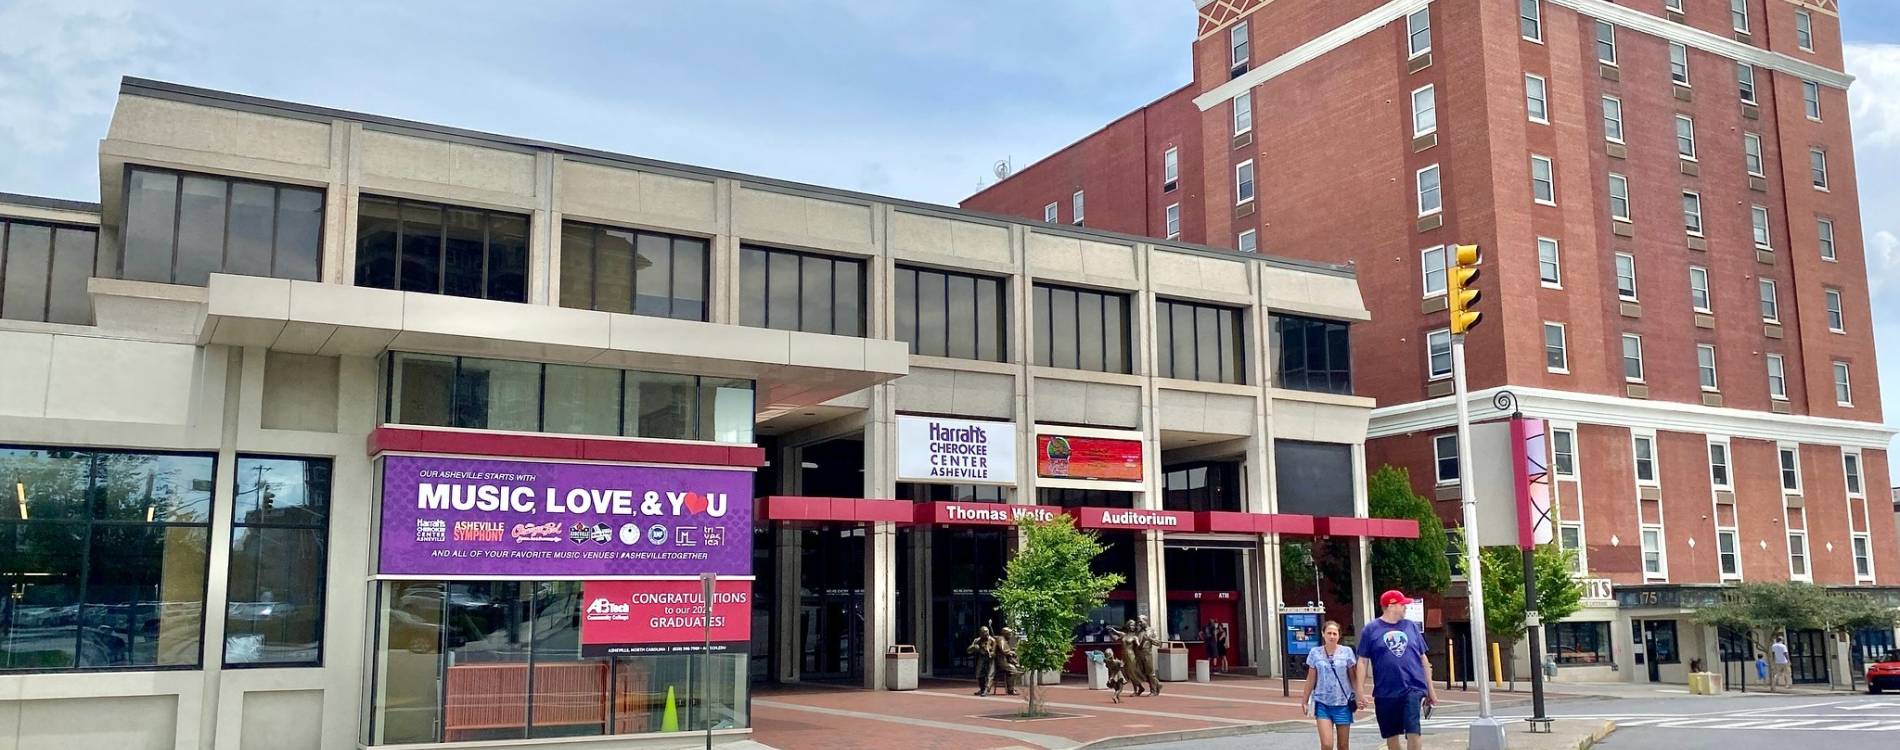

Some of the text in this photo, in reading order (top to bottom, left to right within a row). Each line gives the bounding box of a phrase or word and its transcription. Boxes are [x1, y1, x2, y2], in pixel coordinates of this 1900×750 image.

[929, 422, 987, 443] Harrah's
[929, 442, 987, 455] CHEROKEE
[930, 455, 987, 467] CENTER
[419, 470, 438, 478] OUR
[438, 471, 483, 479] ASHEVILLE
[484, 472, 514, 480] STARTS
[930, 467, 988, 478] ASHEVILLE
[417, 482, 536, 514] MUSIC,
[546, 487, 637, 517] LOVE,
[640, 490, 664, 516] &
[947, 505, 1054, 522] Thomas Wolfe
[1101, 511, 1177, 526] Auditorium
[454, 521, 505, 531] ASHEVILLE
[453, 530, 504, 542] SYMPHONY
[452, 550, 467, 558] ALL
[510, 551, 552, 559] FAVORITE
[620, 552, 708, 560] #ASHEVILLETOGETHER
[632, 592, 746, 604] CONGRATULTIONS
[664, 606, 672, 614] to
[692, 605, 713, 614] 202
[650, 617, 725, 628] GRADUATES!
